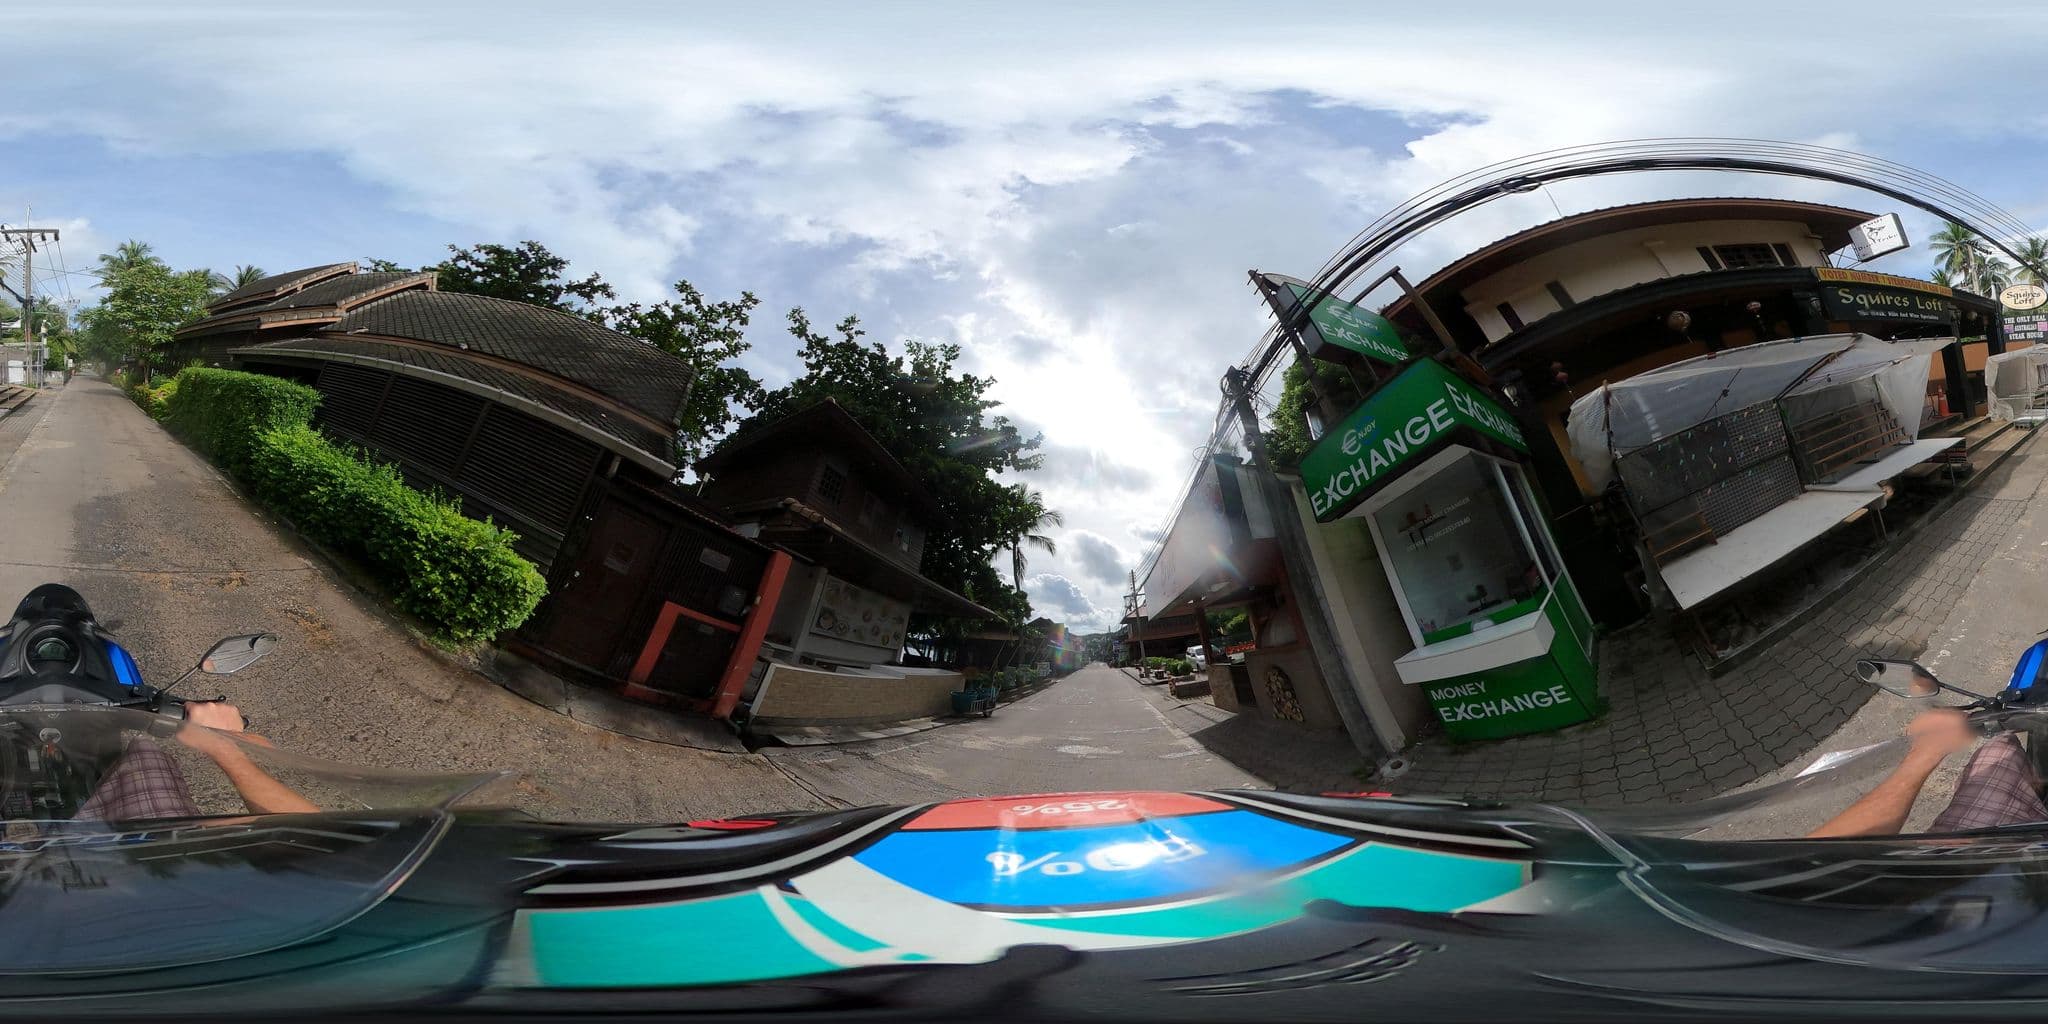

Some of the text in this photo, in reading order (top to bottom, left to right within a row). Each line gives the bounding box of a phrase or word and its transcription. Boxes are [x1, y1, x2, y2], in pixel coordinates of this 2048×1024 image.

[1838, 287, 1944, 312] Squires Loft
[2006, 291, 2041, 300] Squires
[2016, 315, 2031, 323] ONLY
[1319, 320, 1409, 361] EXCHANGE
[2009, 331, 2044, 340] STEAK HOUSE
[1444, 381, 1527, 447] EXCHANGE
[1311, 398, 1455, 517] EXCHANGE
[1430, 680, 1487, 701] MONEY
[1439, 685, 1572, 722] EXCHANGE
[1012, 800, 1128, 816] 25%
